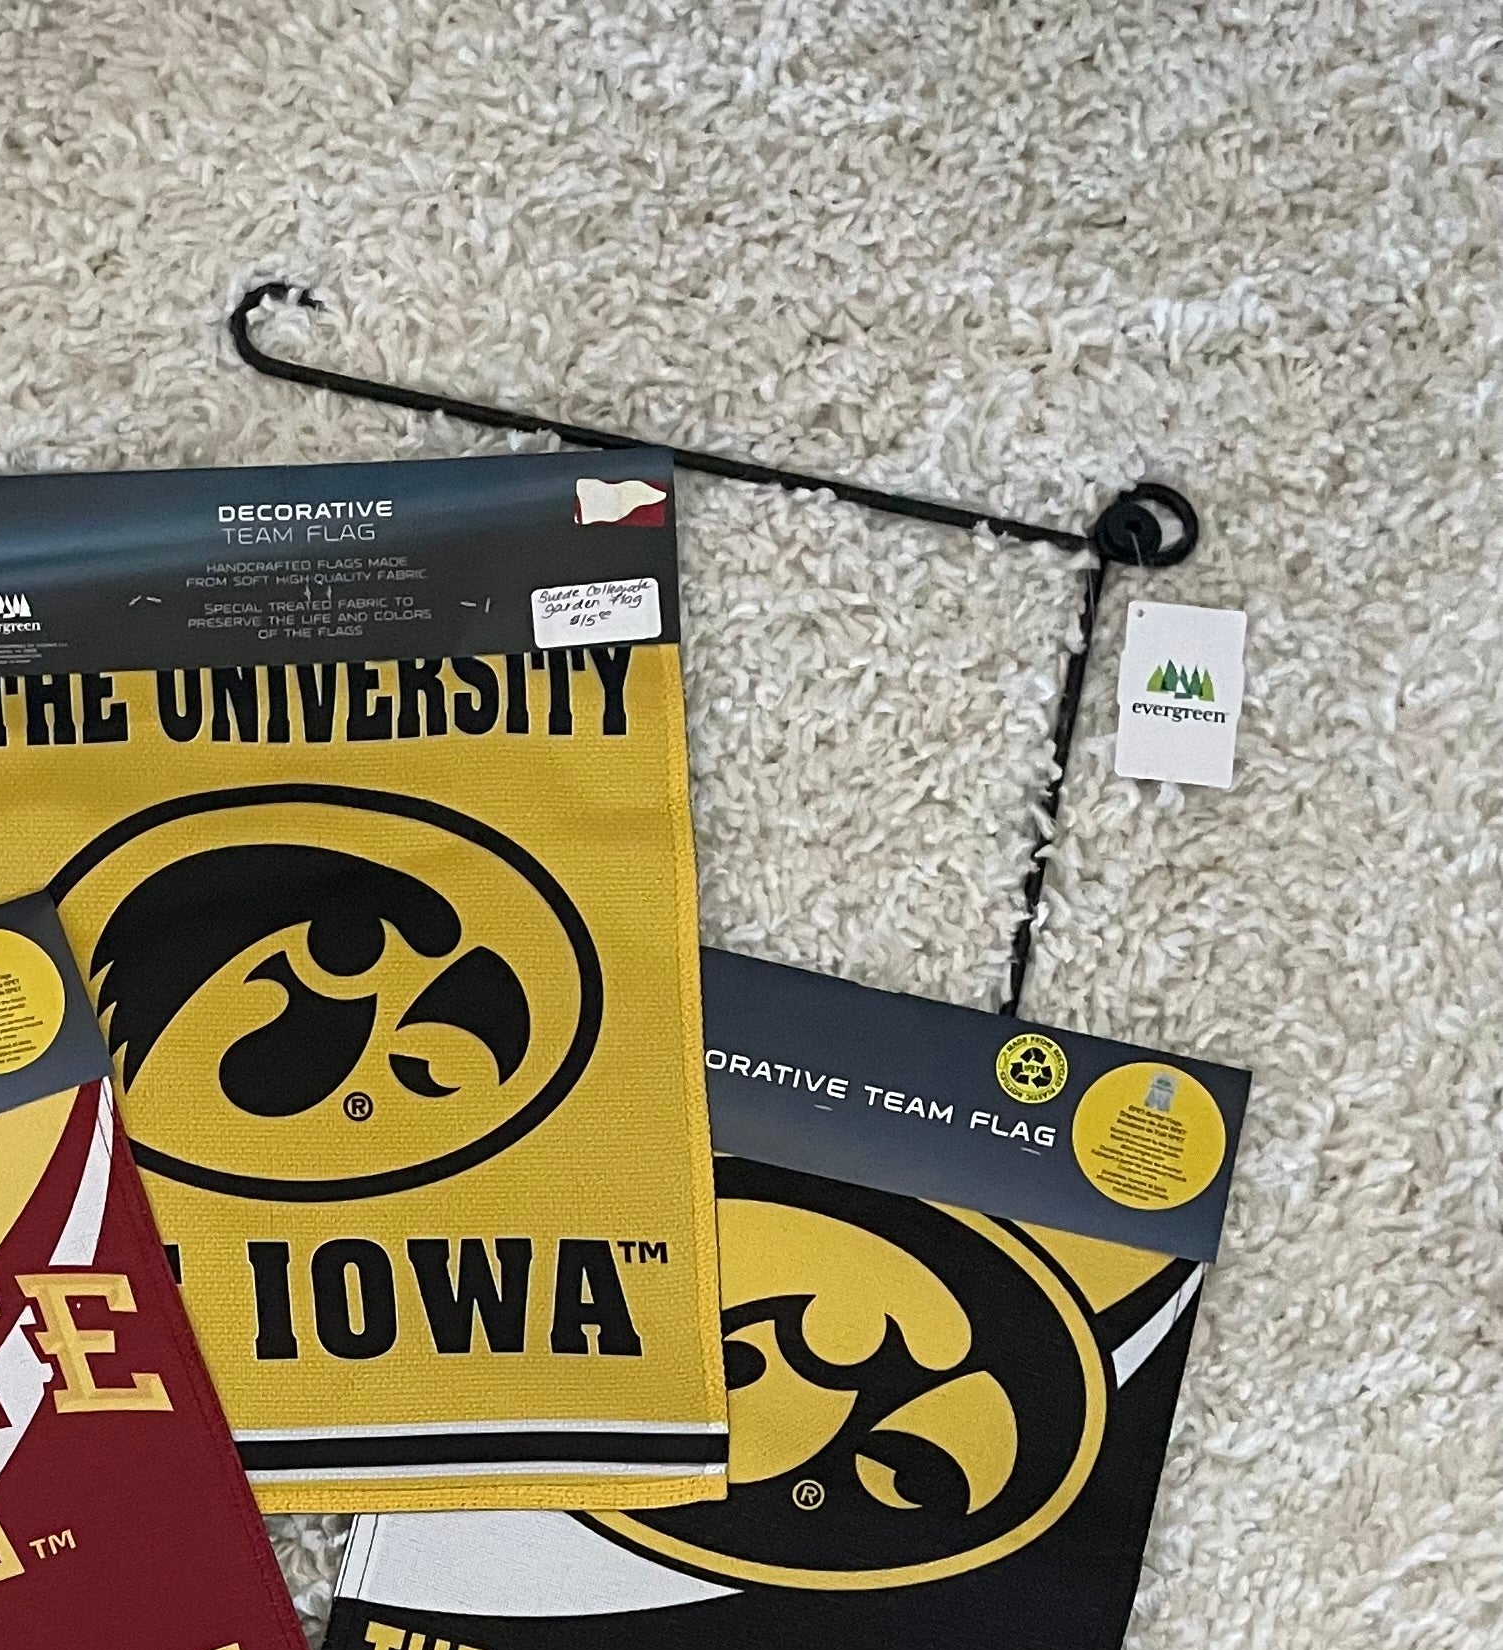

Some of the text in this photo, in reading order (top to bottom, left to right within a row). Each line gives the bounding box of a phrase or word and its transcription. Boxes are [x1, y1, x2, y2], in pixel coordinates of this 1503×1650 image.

[218, 500, 393, 522] DECORATIVE
[221, 523, 376, 545] TEAM FLAG
[206, 556, 408, 573] HANDCRAFTED FLAGS MADE
[186, 577, 227, 588] FROM
[233, 575, 269, 586] SOFT
[377, 568, 428, 580] FABRIC
[204, 596, 414, 615] SPECIAL TREATED FABRIC TO
[188, 609, 432, 629] PRESERVE THE LIFE AND COLORS
[257, 625, 364, 640] OF THE FLAGS
[155, 646, 633, 744] UNIVERSITY
[1131, 702, 1227, 724] evergreen
[704, 1048, 1057, 1148] ORATIVE TEAM FLAG
[246, 1237, 644, 1361] IOWA
